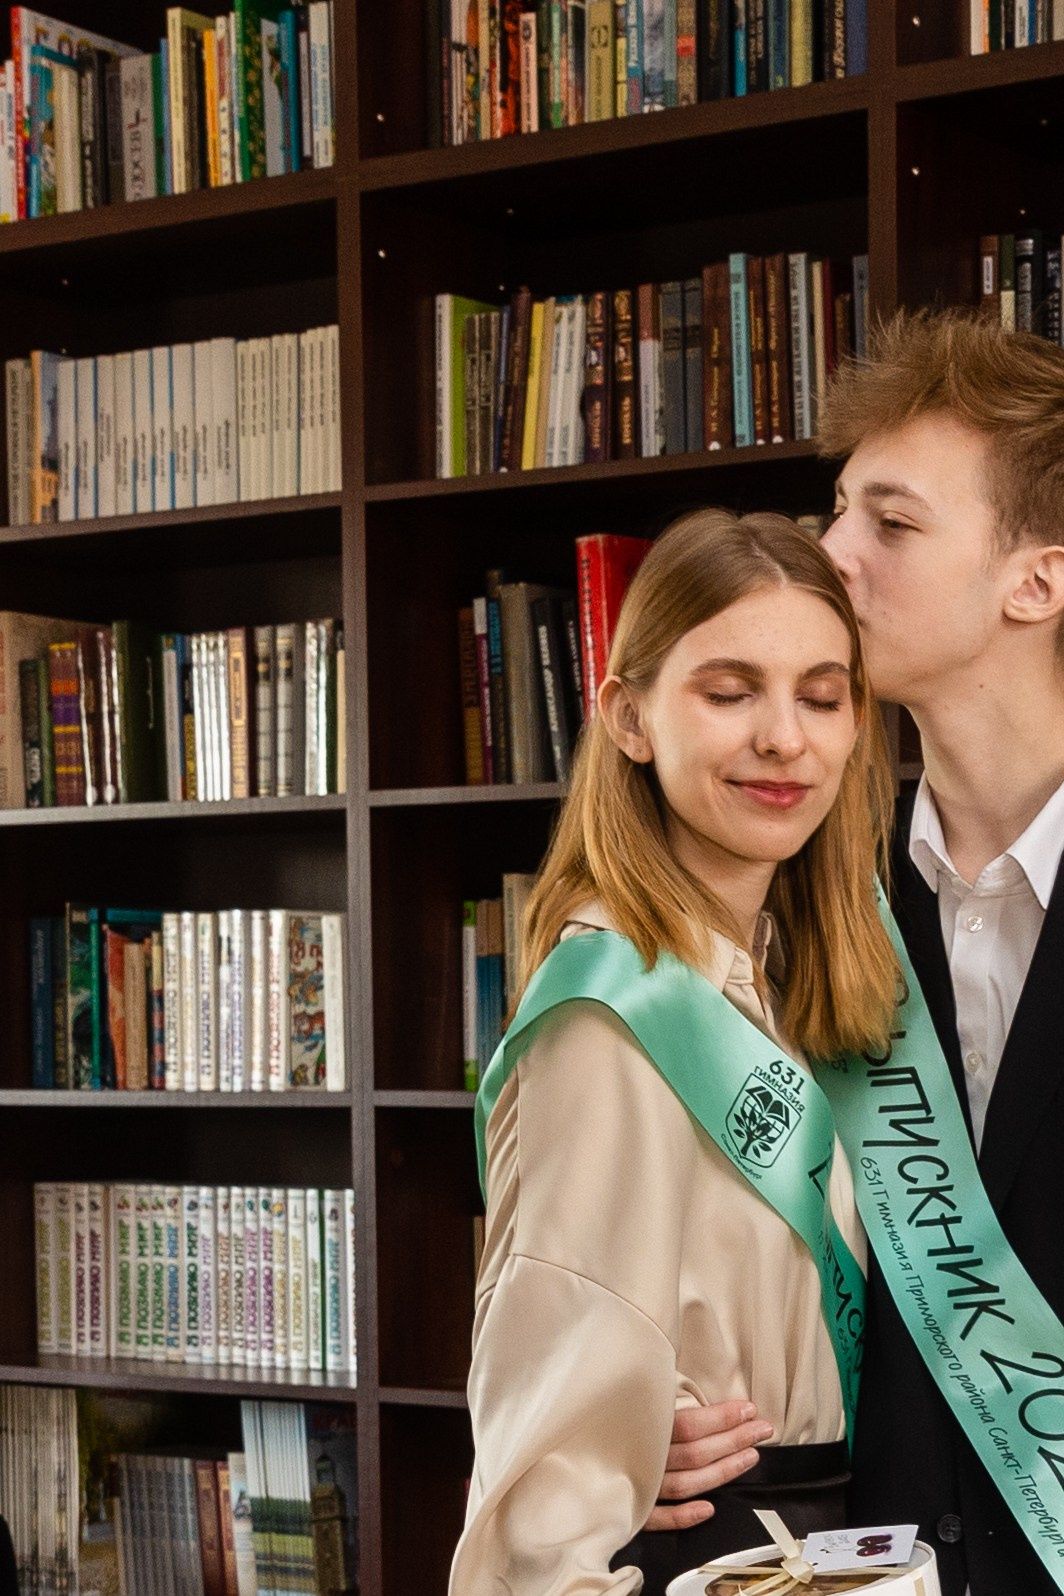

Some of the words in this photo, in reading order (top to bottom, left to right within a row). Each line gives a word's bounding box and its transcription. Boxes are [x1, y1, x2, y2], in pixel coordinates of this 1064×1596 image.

[753, 1065, 806, 1113] ГИМНАЗИЯ
[769, 1059, 805, 1096] 631
[136, 1221, 149, 1257] МИР
[187, 1221, 199, 1258] МИР
[136, 1263, 149, 1330] ПОЗНАЮ
[187, 1263, 199, 1330] ПОЗНАЮ
[860, 1155, 877, 1187] 631
[869, 1189, 915, 1272] Гимназия
[905, 1271, 963, 1371] Приморского
[950, 1370, 993, 1425] района
